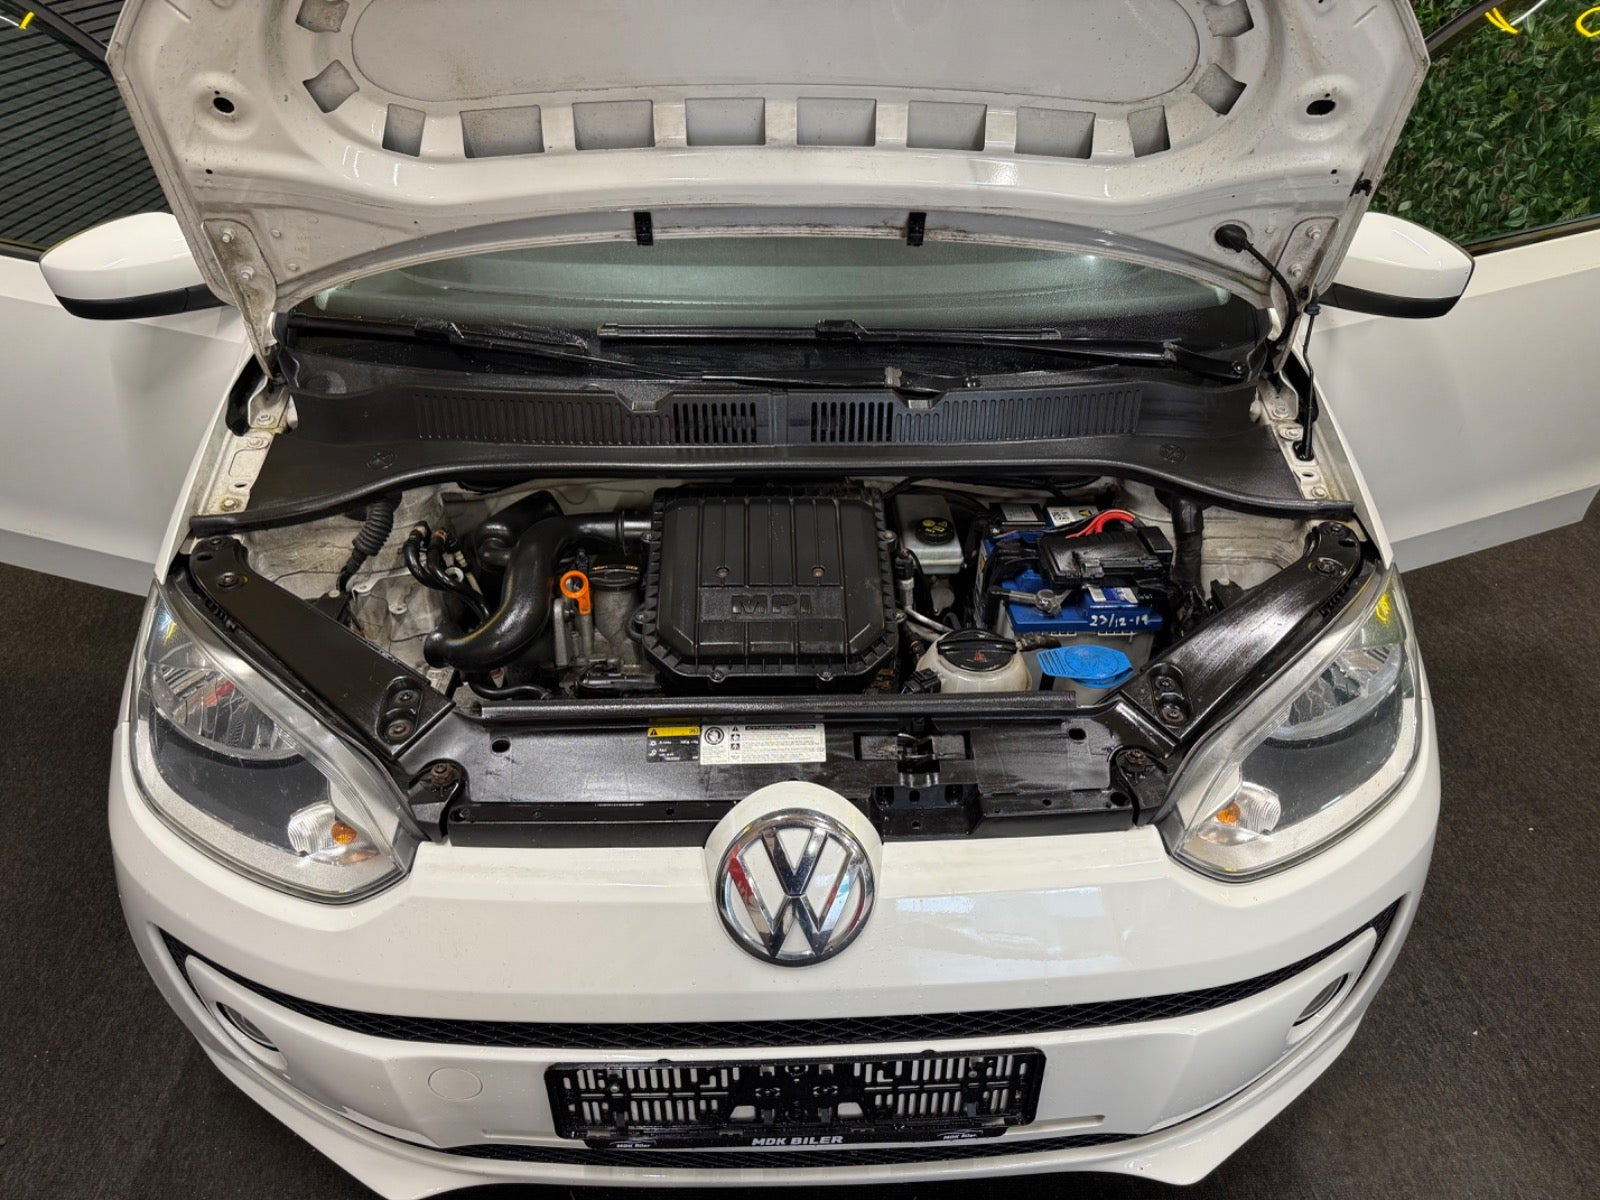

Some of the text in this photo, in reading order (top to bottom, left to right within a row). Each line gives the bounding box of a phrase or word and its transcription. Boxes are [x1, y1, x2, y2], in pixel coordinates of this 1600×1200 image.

[731, 594, 812, 614] MPI
[751, 1135, 844, 1146] MDK BILER
